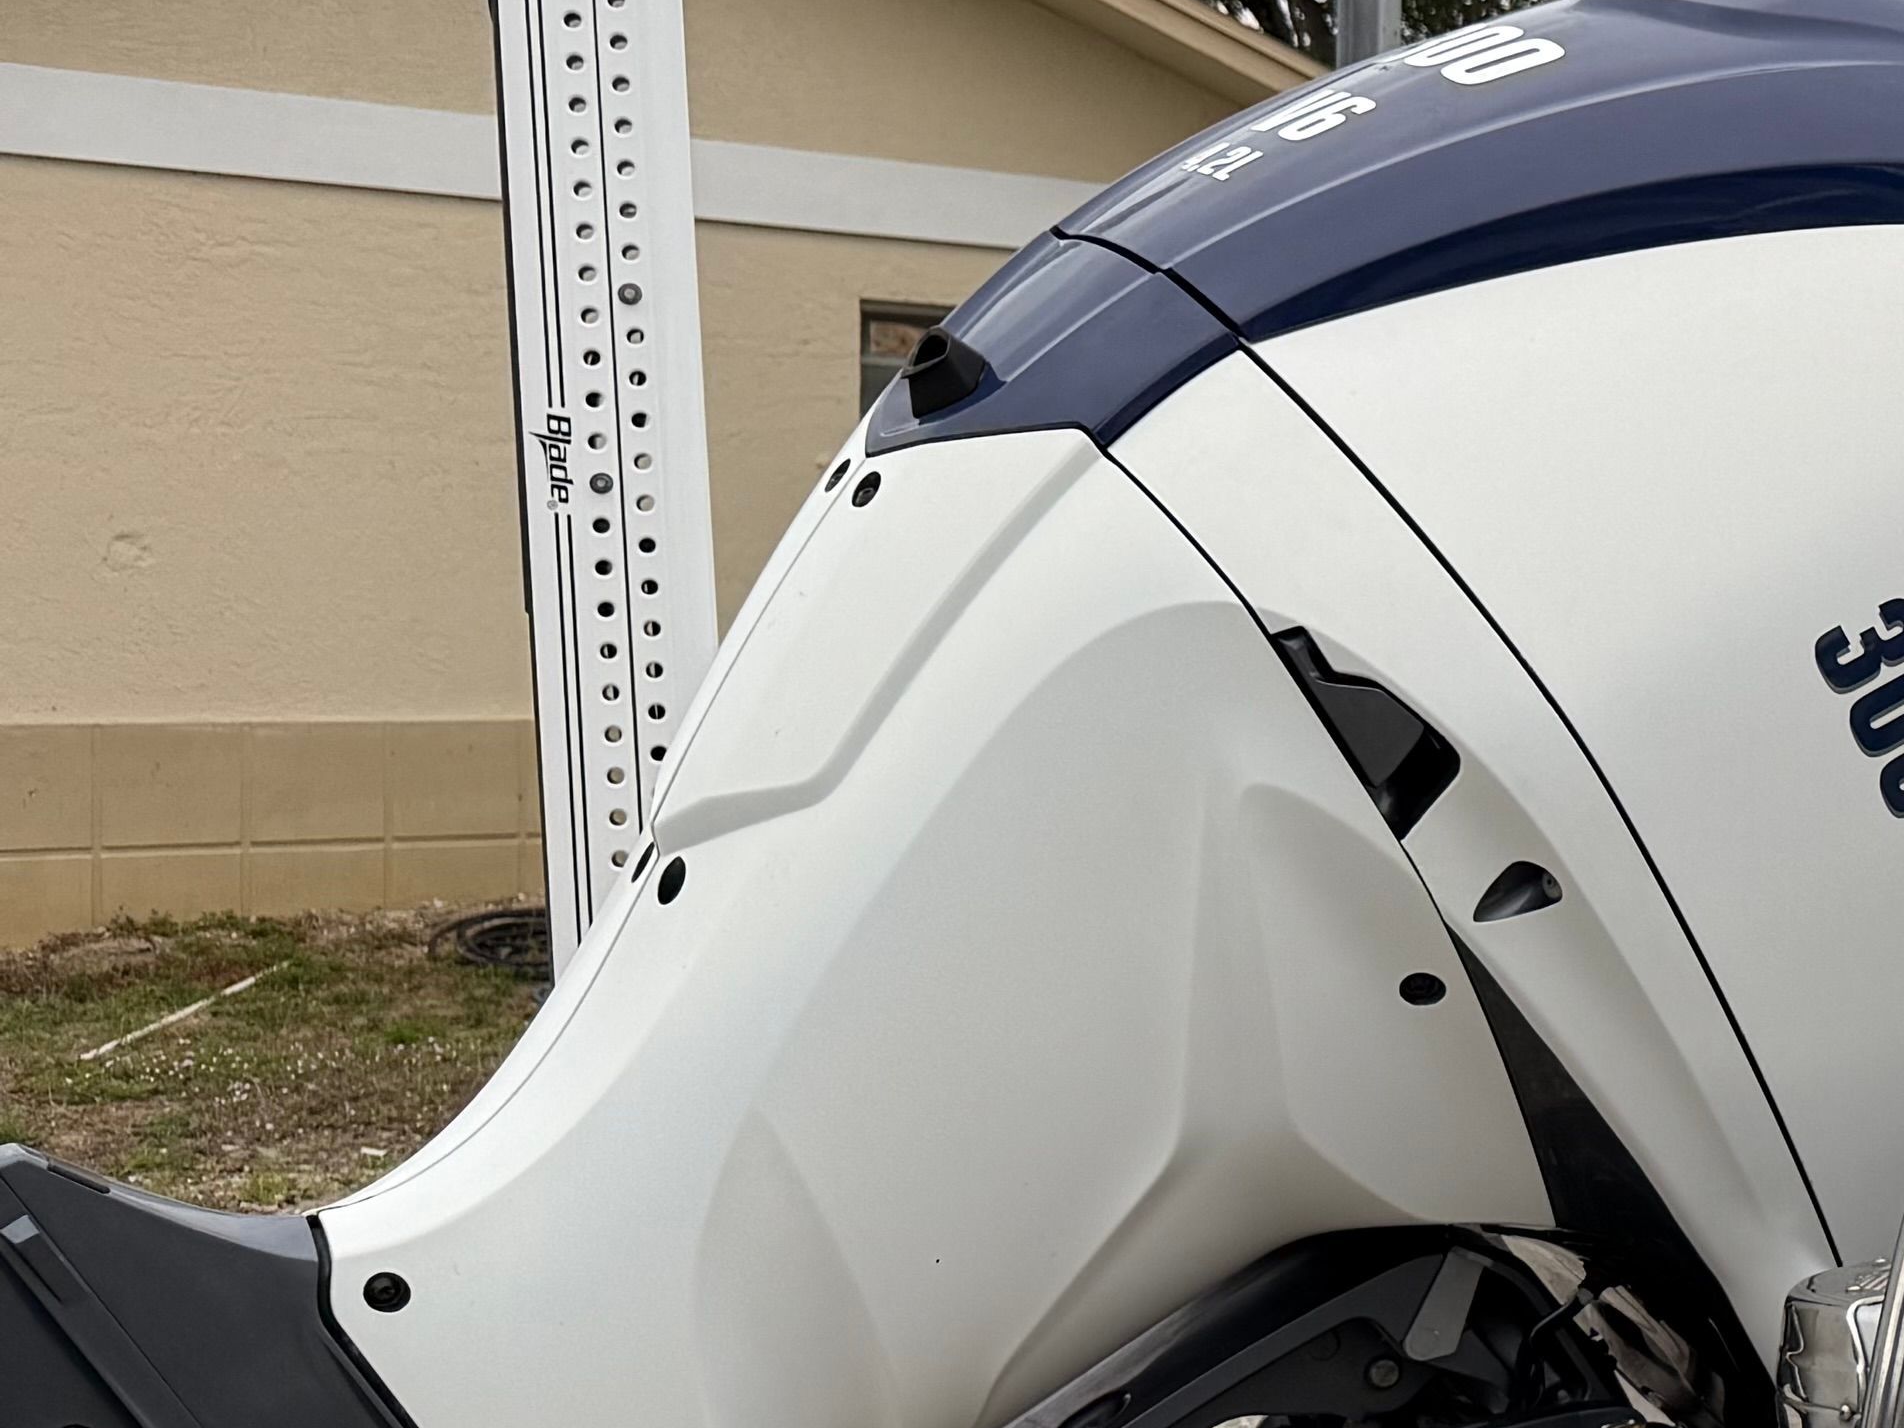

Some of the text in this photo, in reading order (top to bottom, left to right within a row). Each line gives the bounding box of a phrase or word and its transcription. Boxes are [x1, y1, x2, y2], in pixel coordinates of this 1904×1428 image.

[1378, 23, 1565, 85] 00
[1251, 89, 1377, 142] V6
[530, 413, 574, 504] Blade
